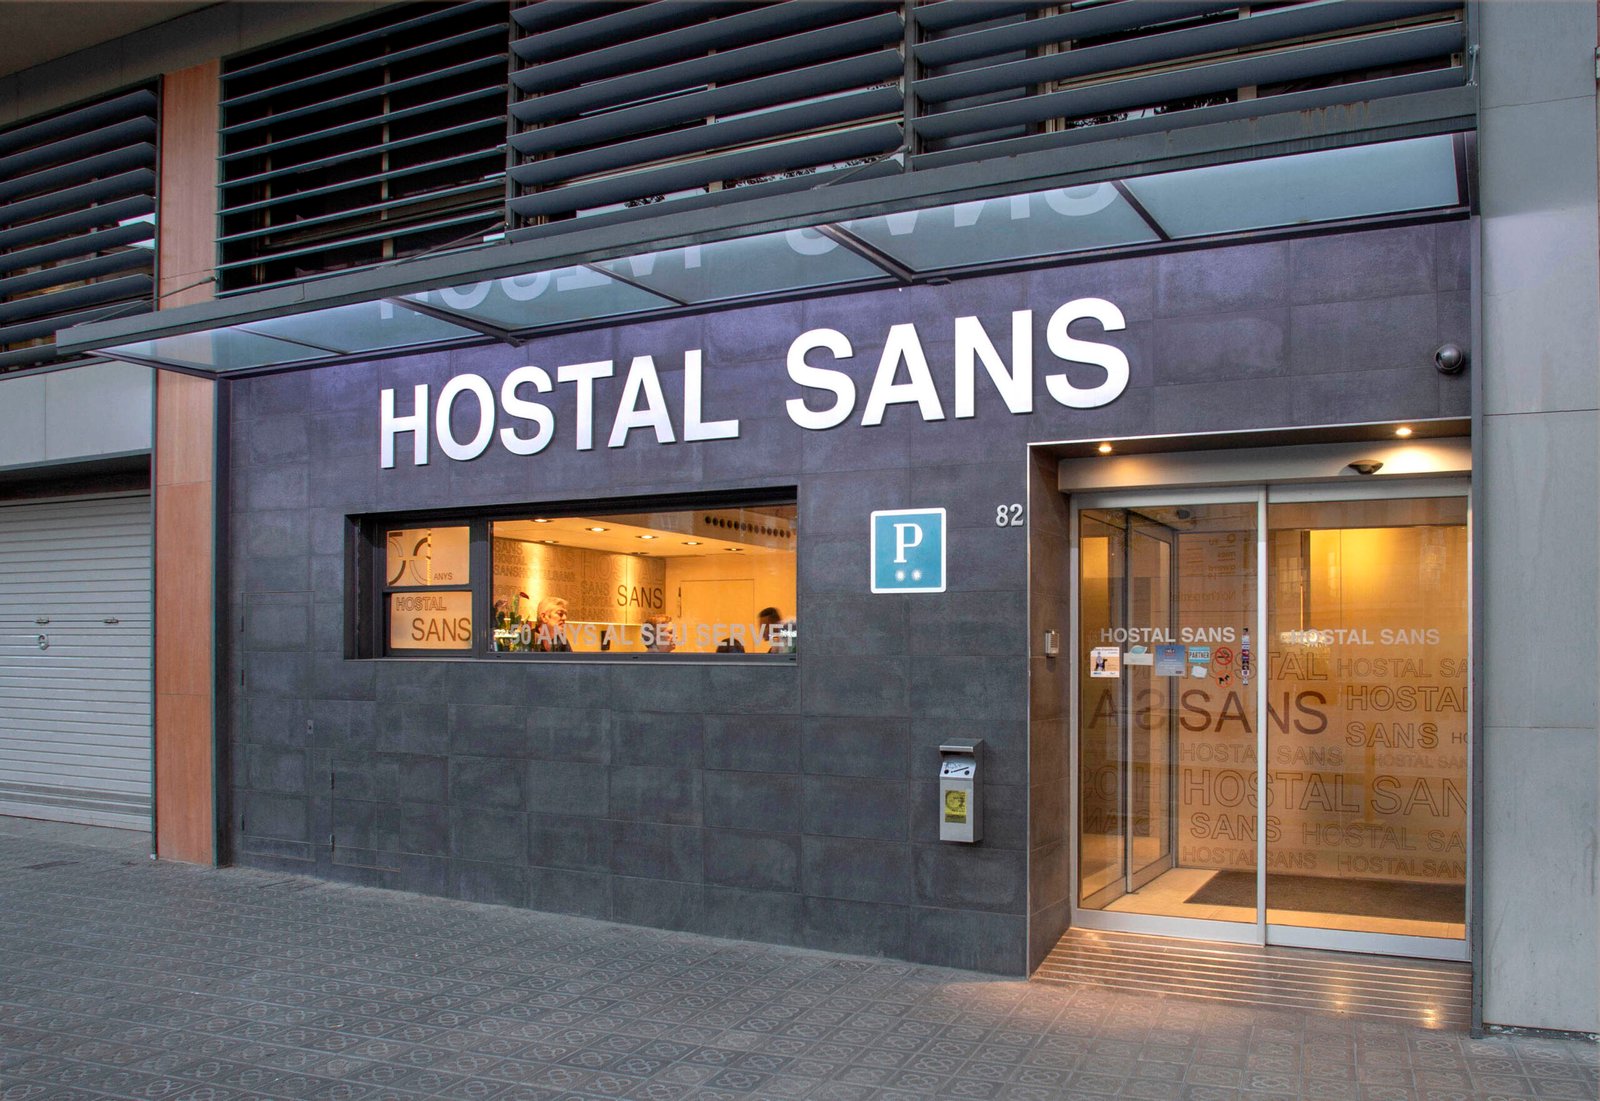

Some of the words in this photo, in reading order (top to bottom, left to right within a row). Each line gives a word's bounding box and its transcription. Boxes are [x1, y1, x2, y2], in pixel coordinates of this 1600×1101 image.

[380, 349, 740, 469] HOSTAL
[785, 297, 1130, 430] SANS
[995, 503, 1024, 527] 82
[893, 523, 923, 564] P
[433, 572, 453, 581] ANYS
[396, 596, 447, 611] HOSTAL
[616, 585, 663, 609] SANS
[411, 617, 472, 642] SANS
[510, 624, 531, 645] 50
[537, 624, 597, 645] ANYS
[603, 624, 633, 645] AL
[640, 624, 687, 646] SEU
[696, 623, 793, 647] SERVEI
[1100, 627, 1176, 643] HOSTAL
[1181, 627, 1236, 643] SANS
[1291, 628, 1374, 645] HOSTAL
[1380, 628, 1440, 645] SANS
[1337, 657, 1432, 678] HOSTAL
[1346, 685, 1468, 712] HOSTA
[1180, 688, 1328, 735] SANS
[1345, 721, 1439, 749] SANS
[1276, 745, 1343, 767] SANS
[1184, 768, 1360, 813] HOSTAL
[1190, 812, 1282, 843] SANS
[1302, 822, 1417, 850] HOSTAL
